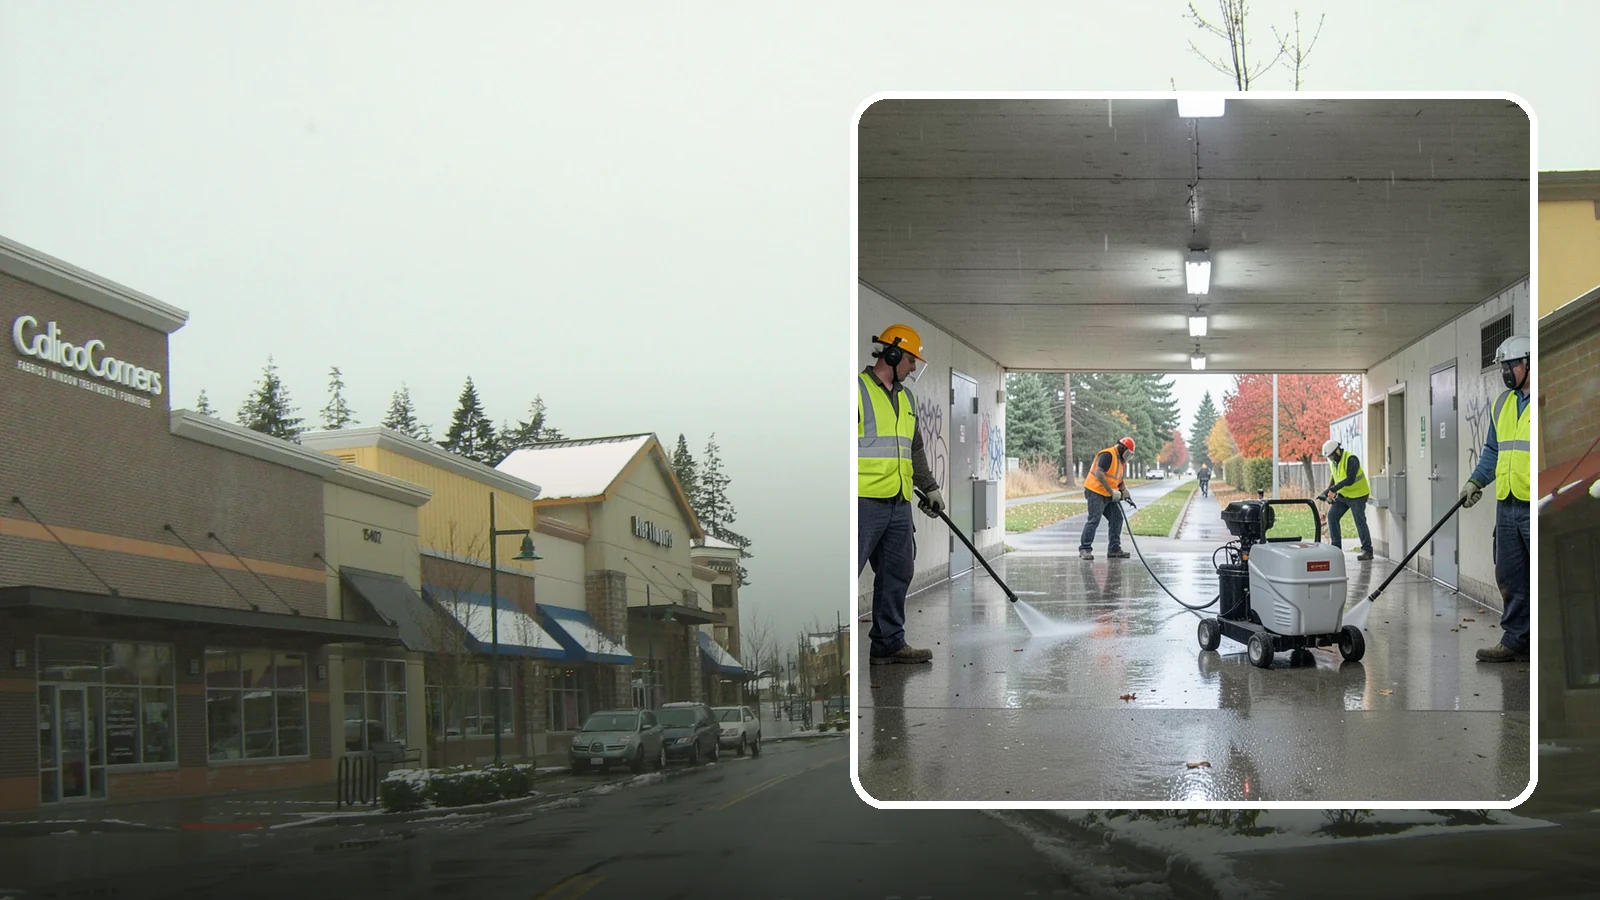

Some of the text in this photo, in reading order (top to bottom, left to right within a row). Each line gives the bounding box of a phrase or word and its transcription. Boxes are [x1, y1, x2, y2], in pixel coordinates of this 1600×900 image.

[16, 360, 46, 377] FABRICS
[51, 370, 78, 387] WINDOW
[79, 379, 116, 398] TREATMENTS
[120, 391, 151, 409] FURNITURE
